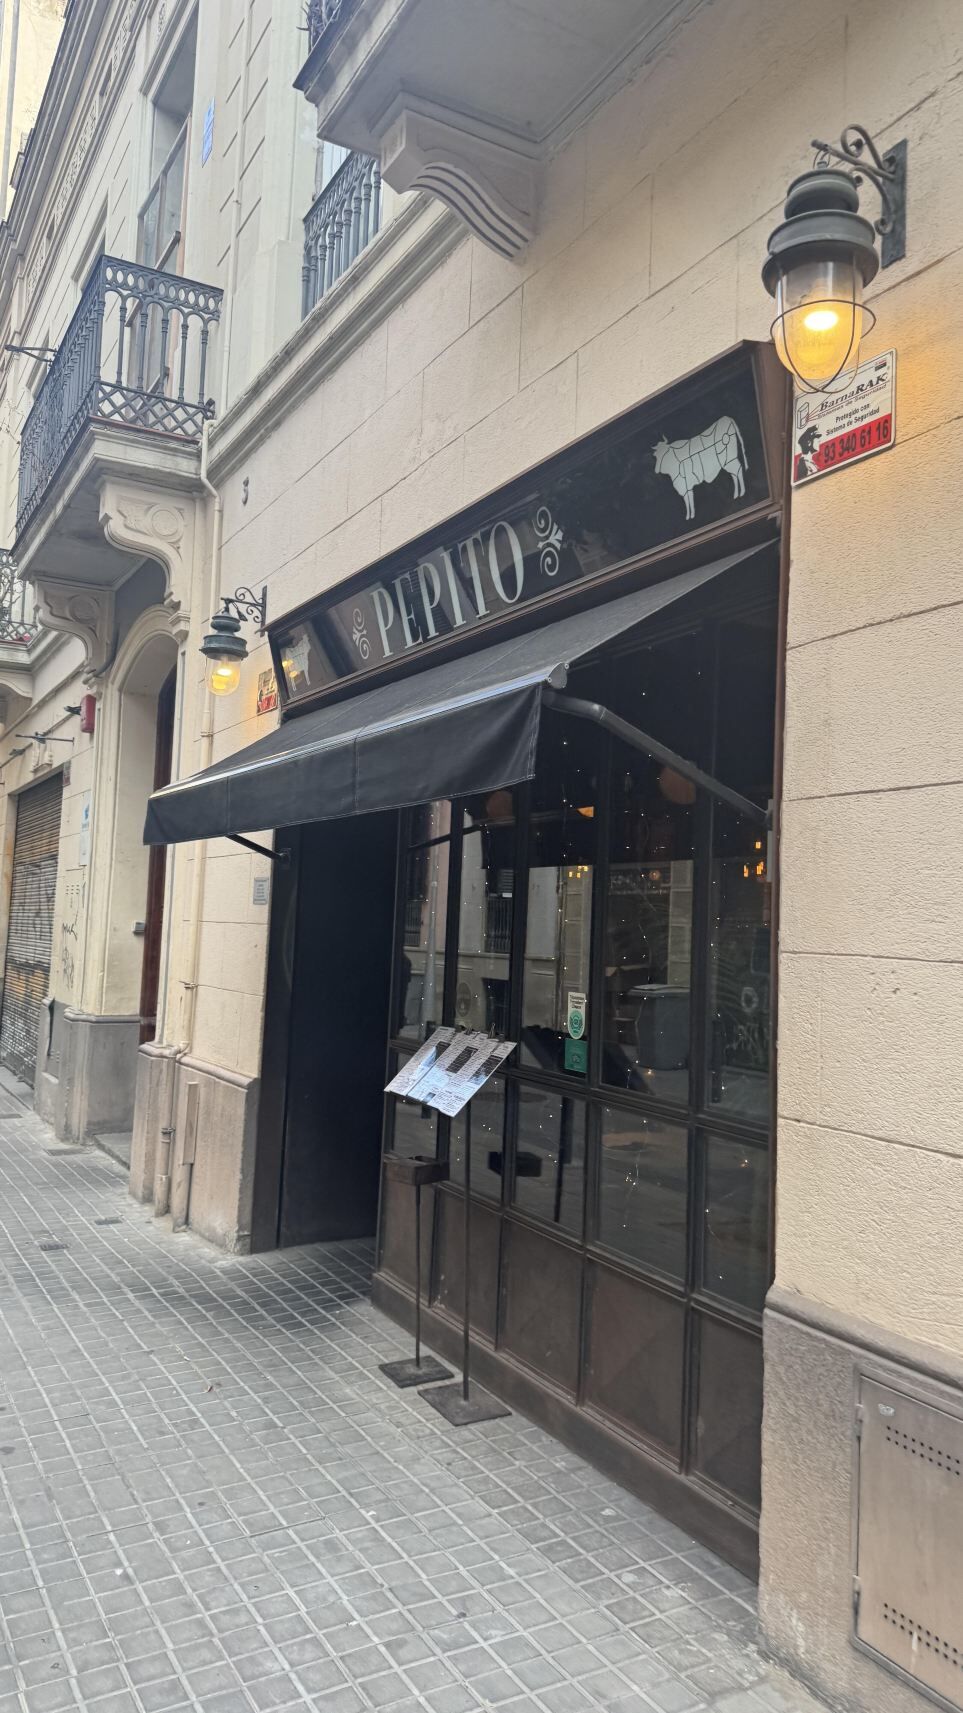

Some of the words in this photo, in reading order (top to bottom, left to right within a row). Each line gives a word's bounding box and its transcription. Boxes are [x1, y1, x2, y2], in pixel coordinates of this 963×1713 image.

[819, 373, 888, 412] BarnaRAK
[825, 424, 846, 436] Sistema
[846, 420, 853, 428] de
[854, 406, 880, 424] Seguridad
[835, 408, 860, 423] Protegido
[861, 403, 870, 412] con
[824, 443, 835, 463] 93
[839, 434, 856, 457] 340
[861, 426, 871, 448] 61
[877, 420, 889, 442] 16
[370, 521, 524, 658] PEPITO
